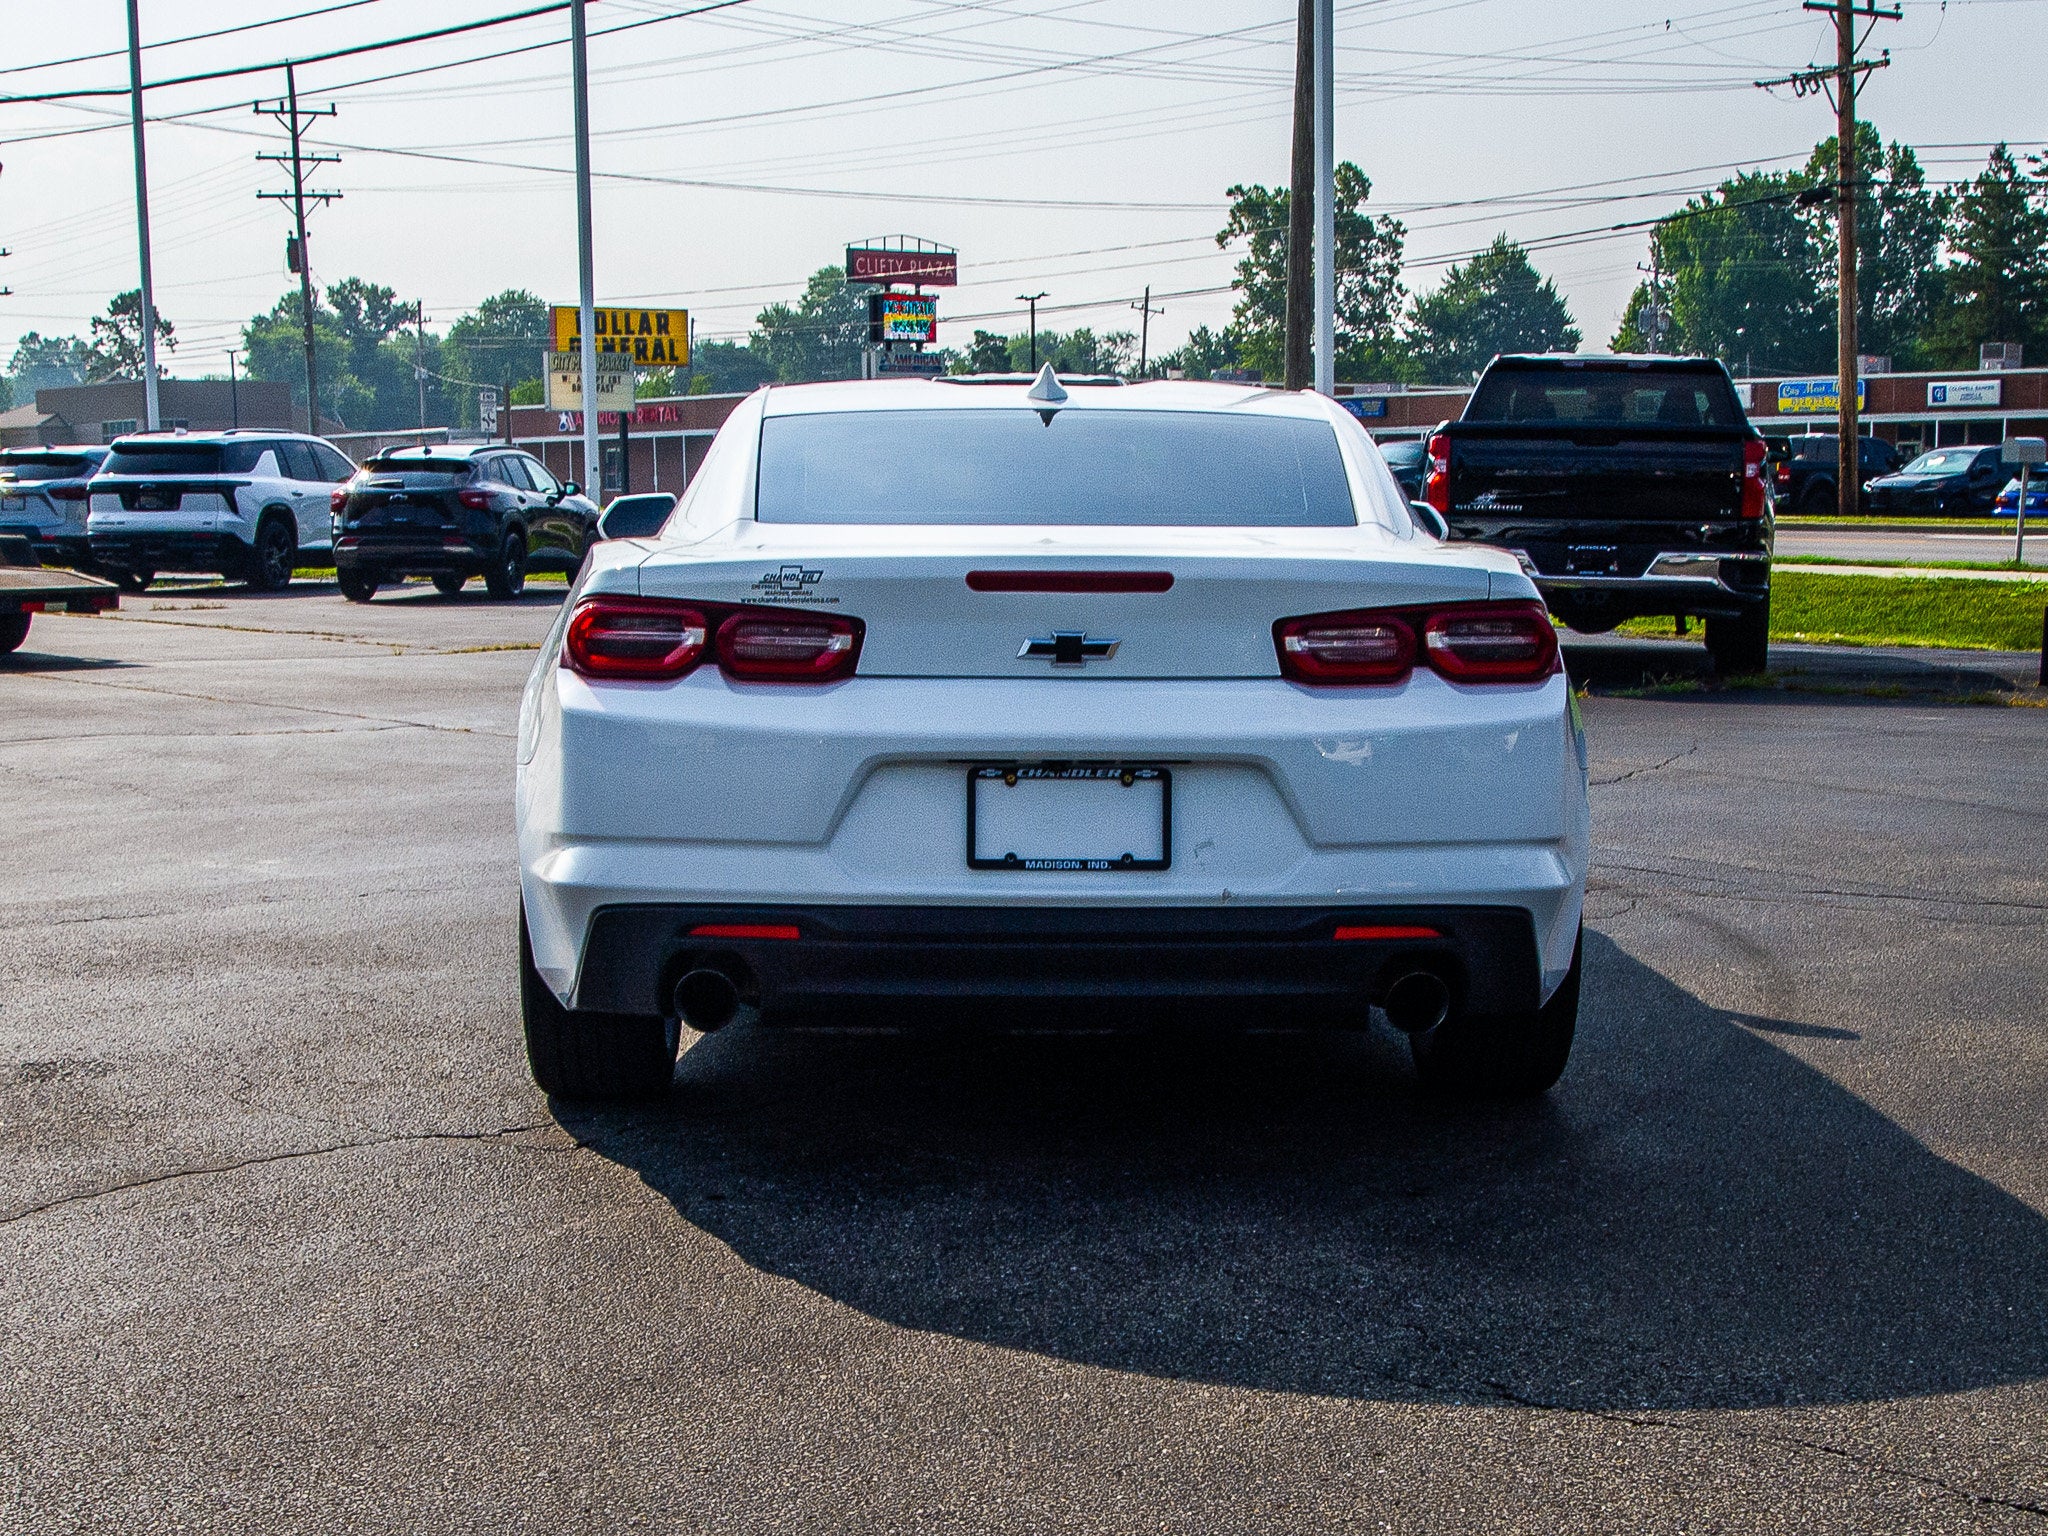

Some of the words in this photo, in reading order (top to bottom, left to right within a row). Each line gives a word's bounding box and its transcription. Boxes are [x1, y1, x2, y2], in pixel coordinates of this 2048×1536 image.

[856, 257, 903, 274] CLIFTY
[910, 260, 954, 277] PLAZA
[636, 403, 678, 423] RENTAL
[763, 573, 815, 582] CHANDLER
[1016, 768, 1122, 778] CHANDLER
